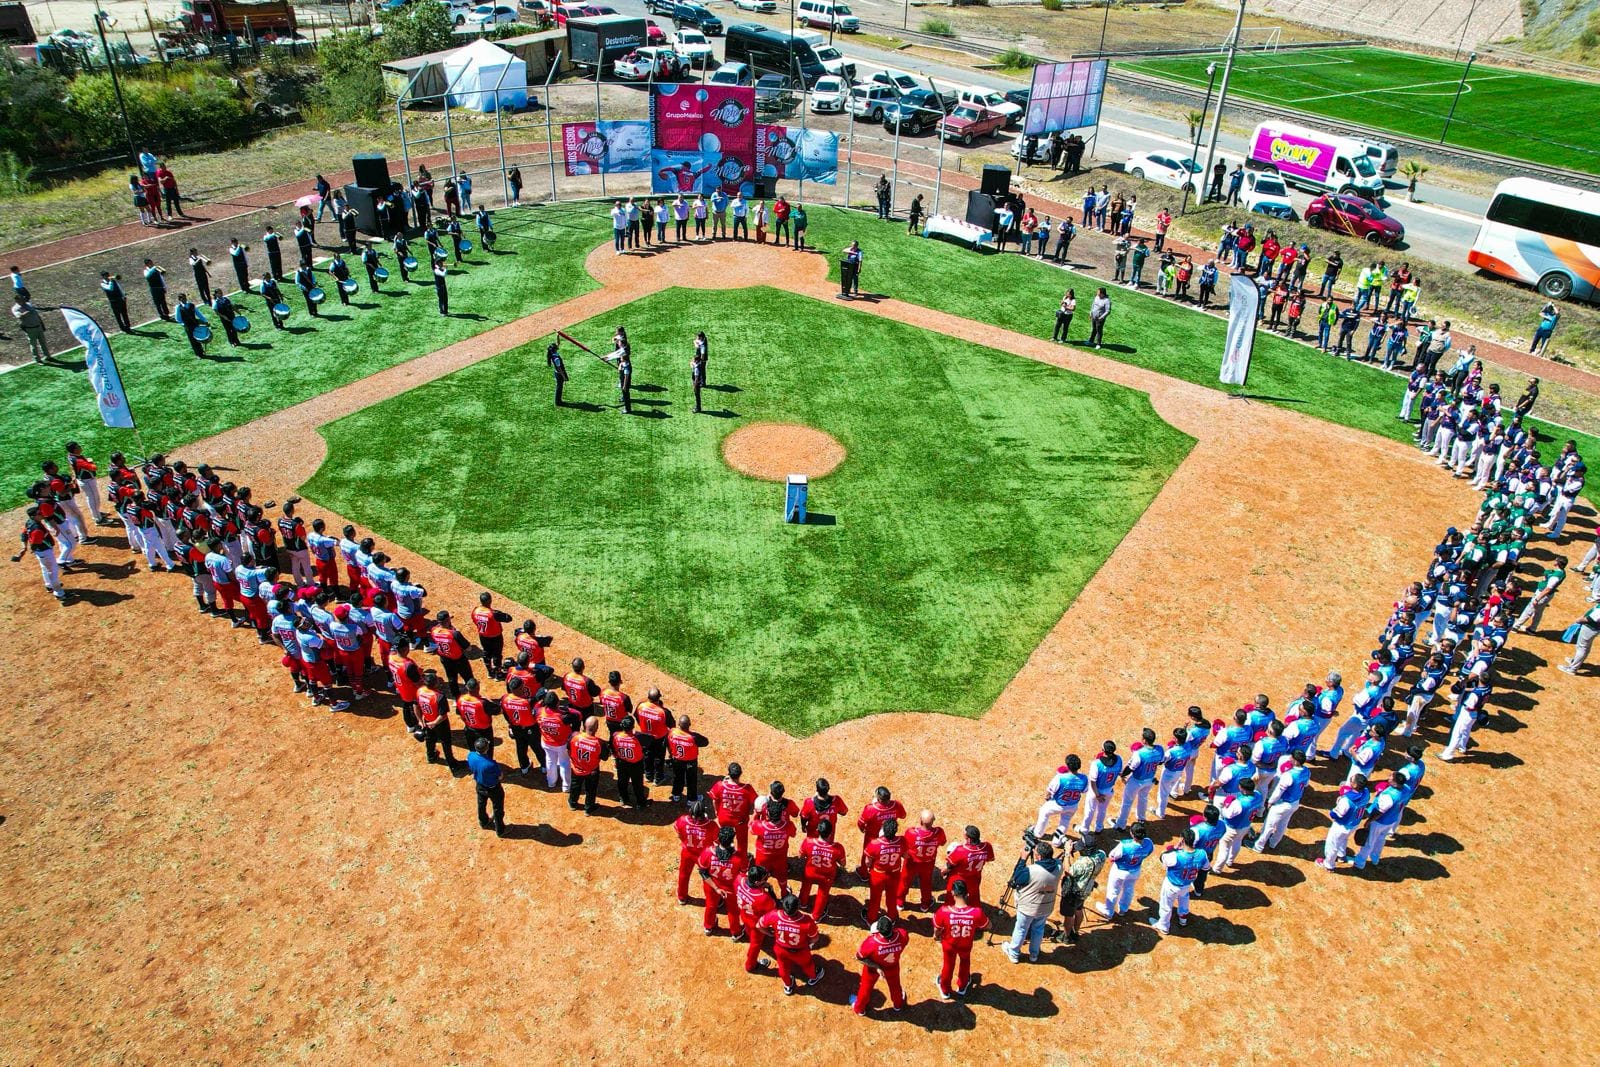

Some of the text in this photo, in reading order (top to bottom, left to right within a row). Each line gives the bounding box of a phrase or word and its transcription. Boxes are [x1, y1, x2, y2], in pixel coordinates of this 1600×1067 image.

[512, 710, 520, 722] 4
[646, 720, 652, 731] 1
[578, 749, 590, 762] 14
[1181, 868, 1198, 880] 12
[950, 925, 972, 938] 26
[778, 932, 800, 946] 13
[884, 952, 896, 963] 4
